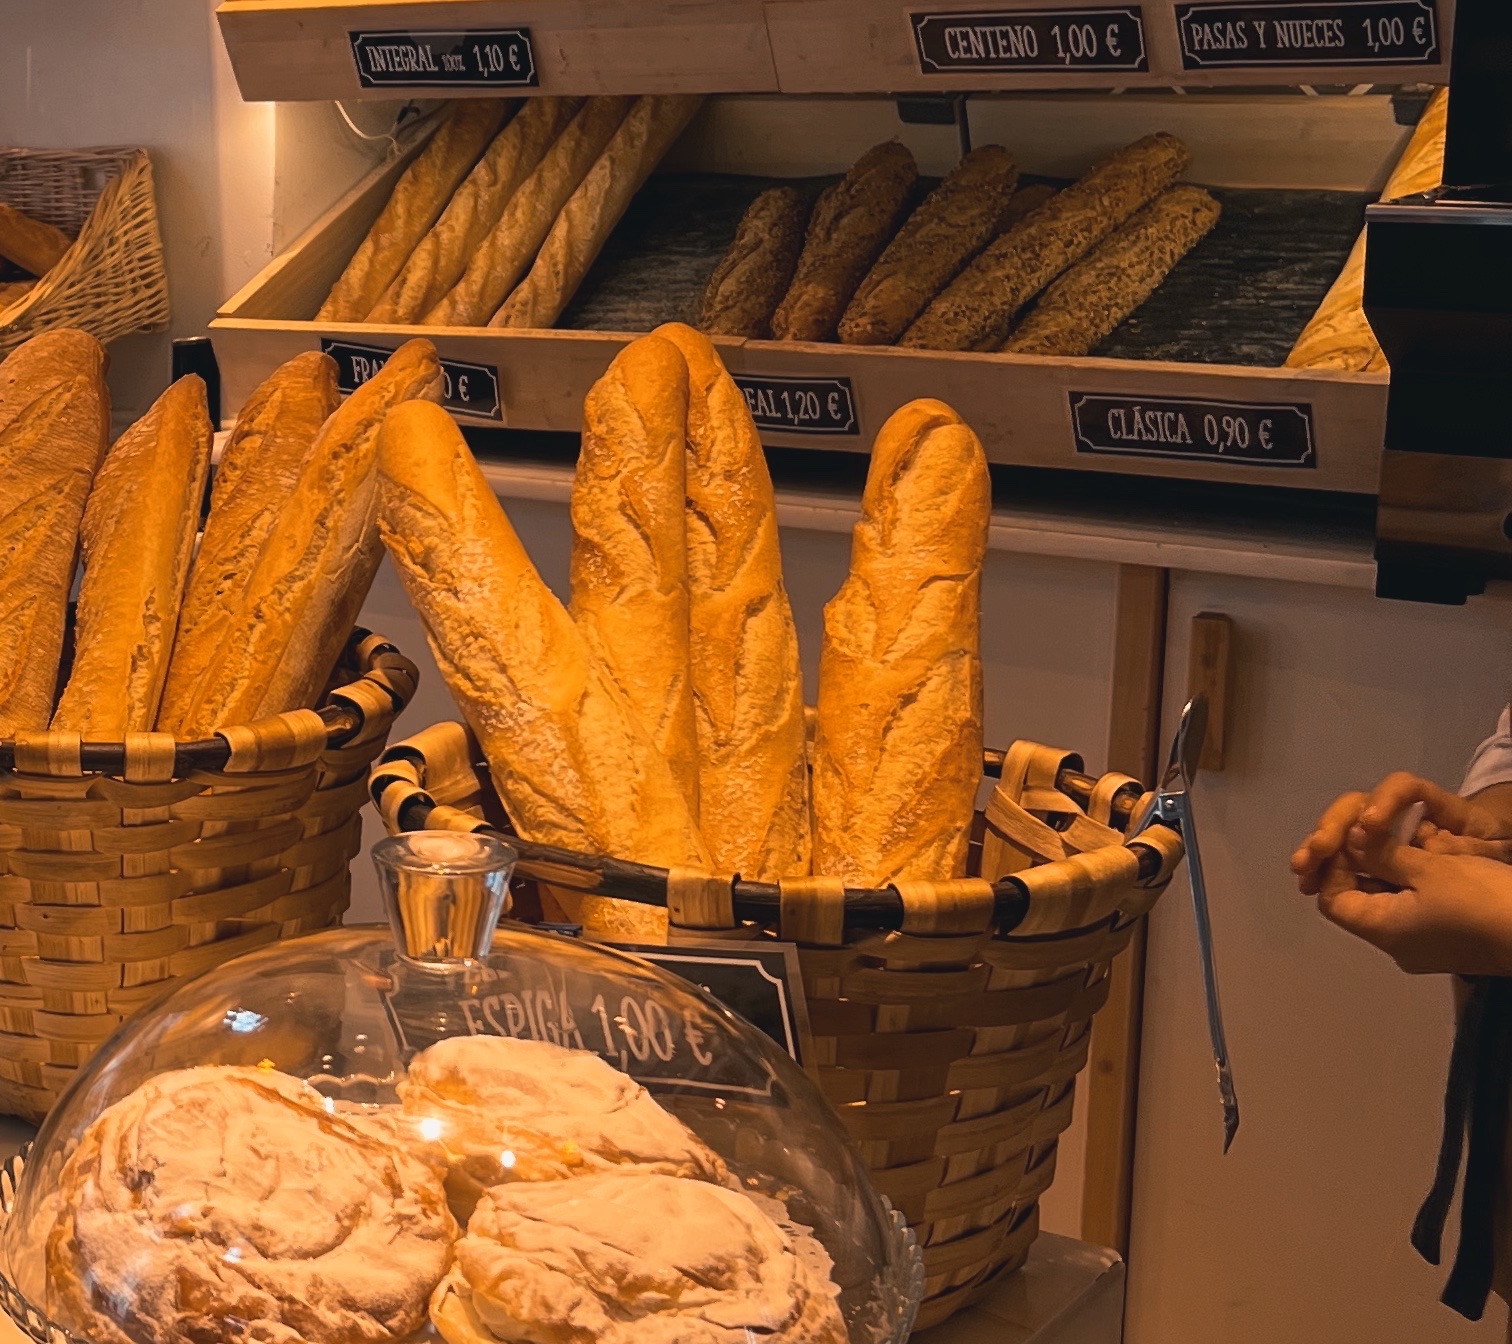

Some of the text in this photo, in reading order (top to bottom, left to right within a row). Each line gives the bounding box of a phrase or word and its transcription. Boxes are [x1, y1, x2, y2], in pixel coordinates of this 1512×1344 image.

[944, 23, 1121, 65] CENTENO 1,00 €
[1190, 16, 1426, 53] PASAS Y NUECES 1,00 €
[366, 44, 438, 72] INTEGRAL
[473, 44, 504, 78] 1,10
[509, 44, 521, 71] €
[350, 355, 386, 384] FRA
[458, 374, 470, 402] €
[743, 387, 841, 425] EAL 1,20 €
[1107, 406, 1273, 453] CLÁSICA 0,90 €
[458, 990, 713, 1073] ESPIGA 1,00 €
